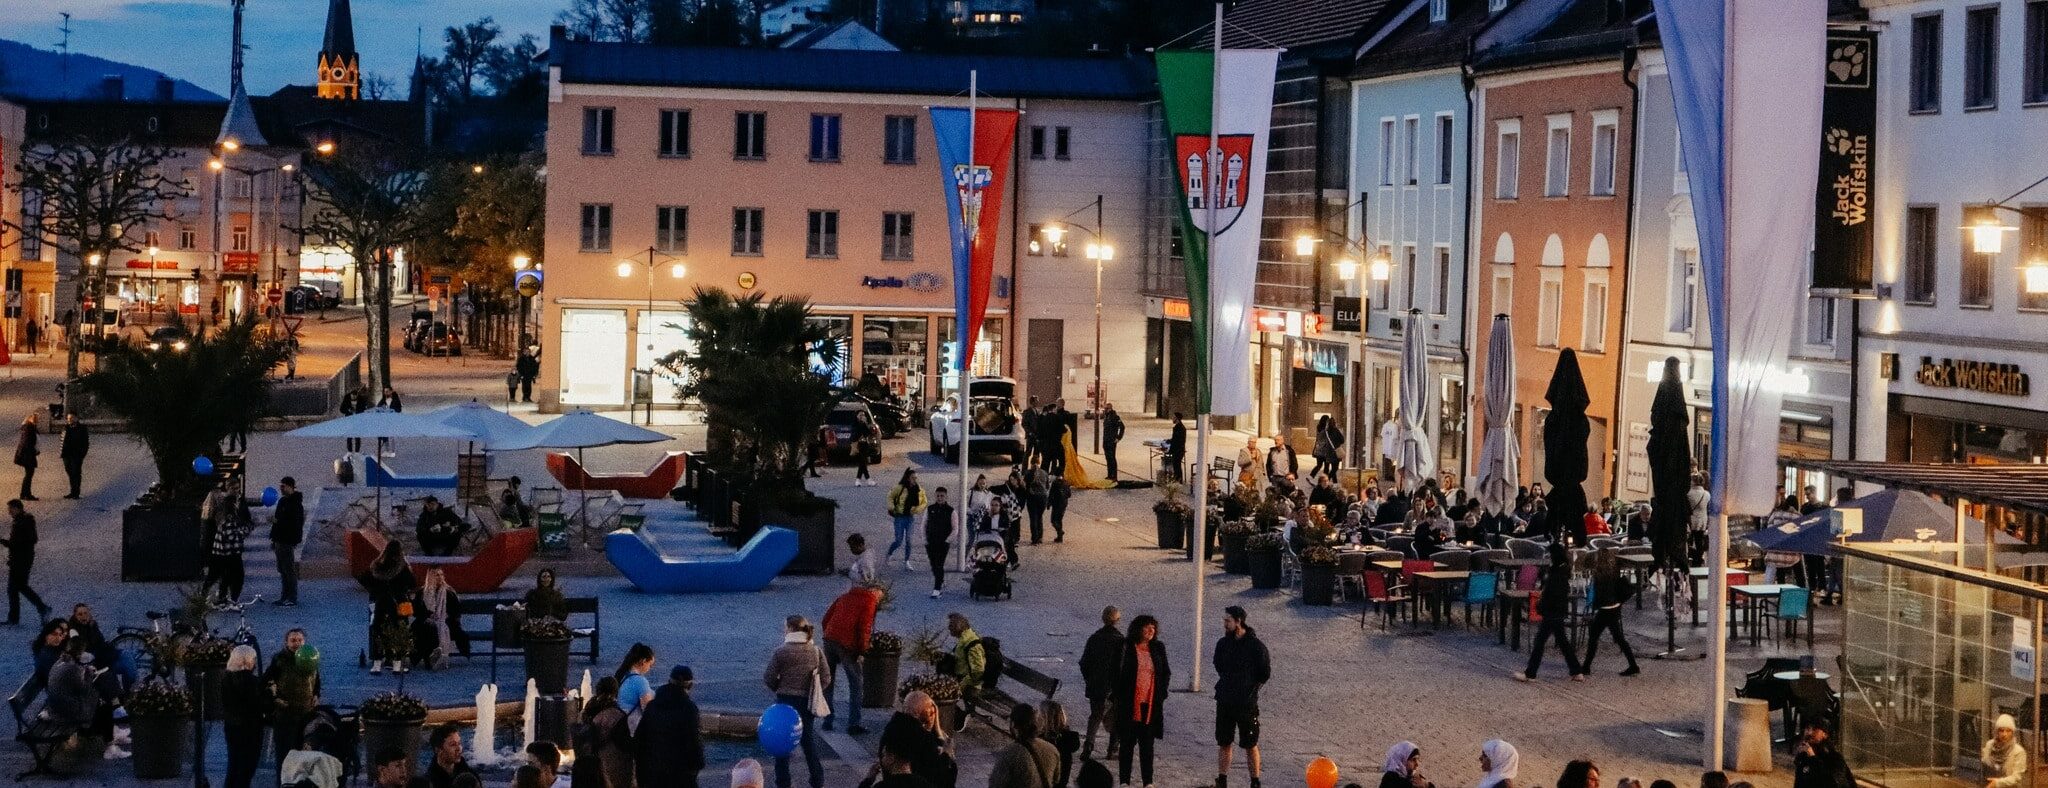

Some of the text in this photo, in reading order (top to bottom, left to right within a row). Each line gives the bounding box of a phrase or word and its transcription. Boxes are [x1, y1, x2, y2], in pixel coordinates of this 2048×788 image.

[1832, 174, 1850, 226] Jack
[1849, 135, 1867, 226] Wolfskin
[1336, 310, 1361, 322] ELLA
[1915, 356, 2023, 396] Jack Wolfskin
